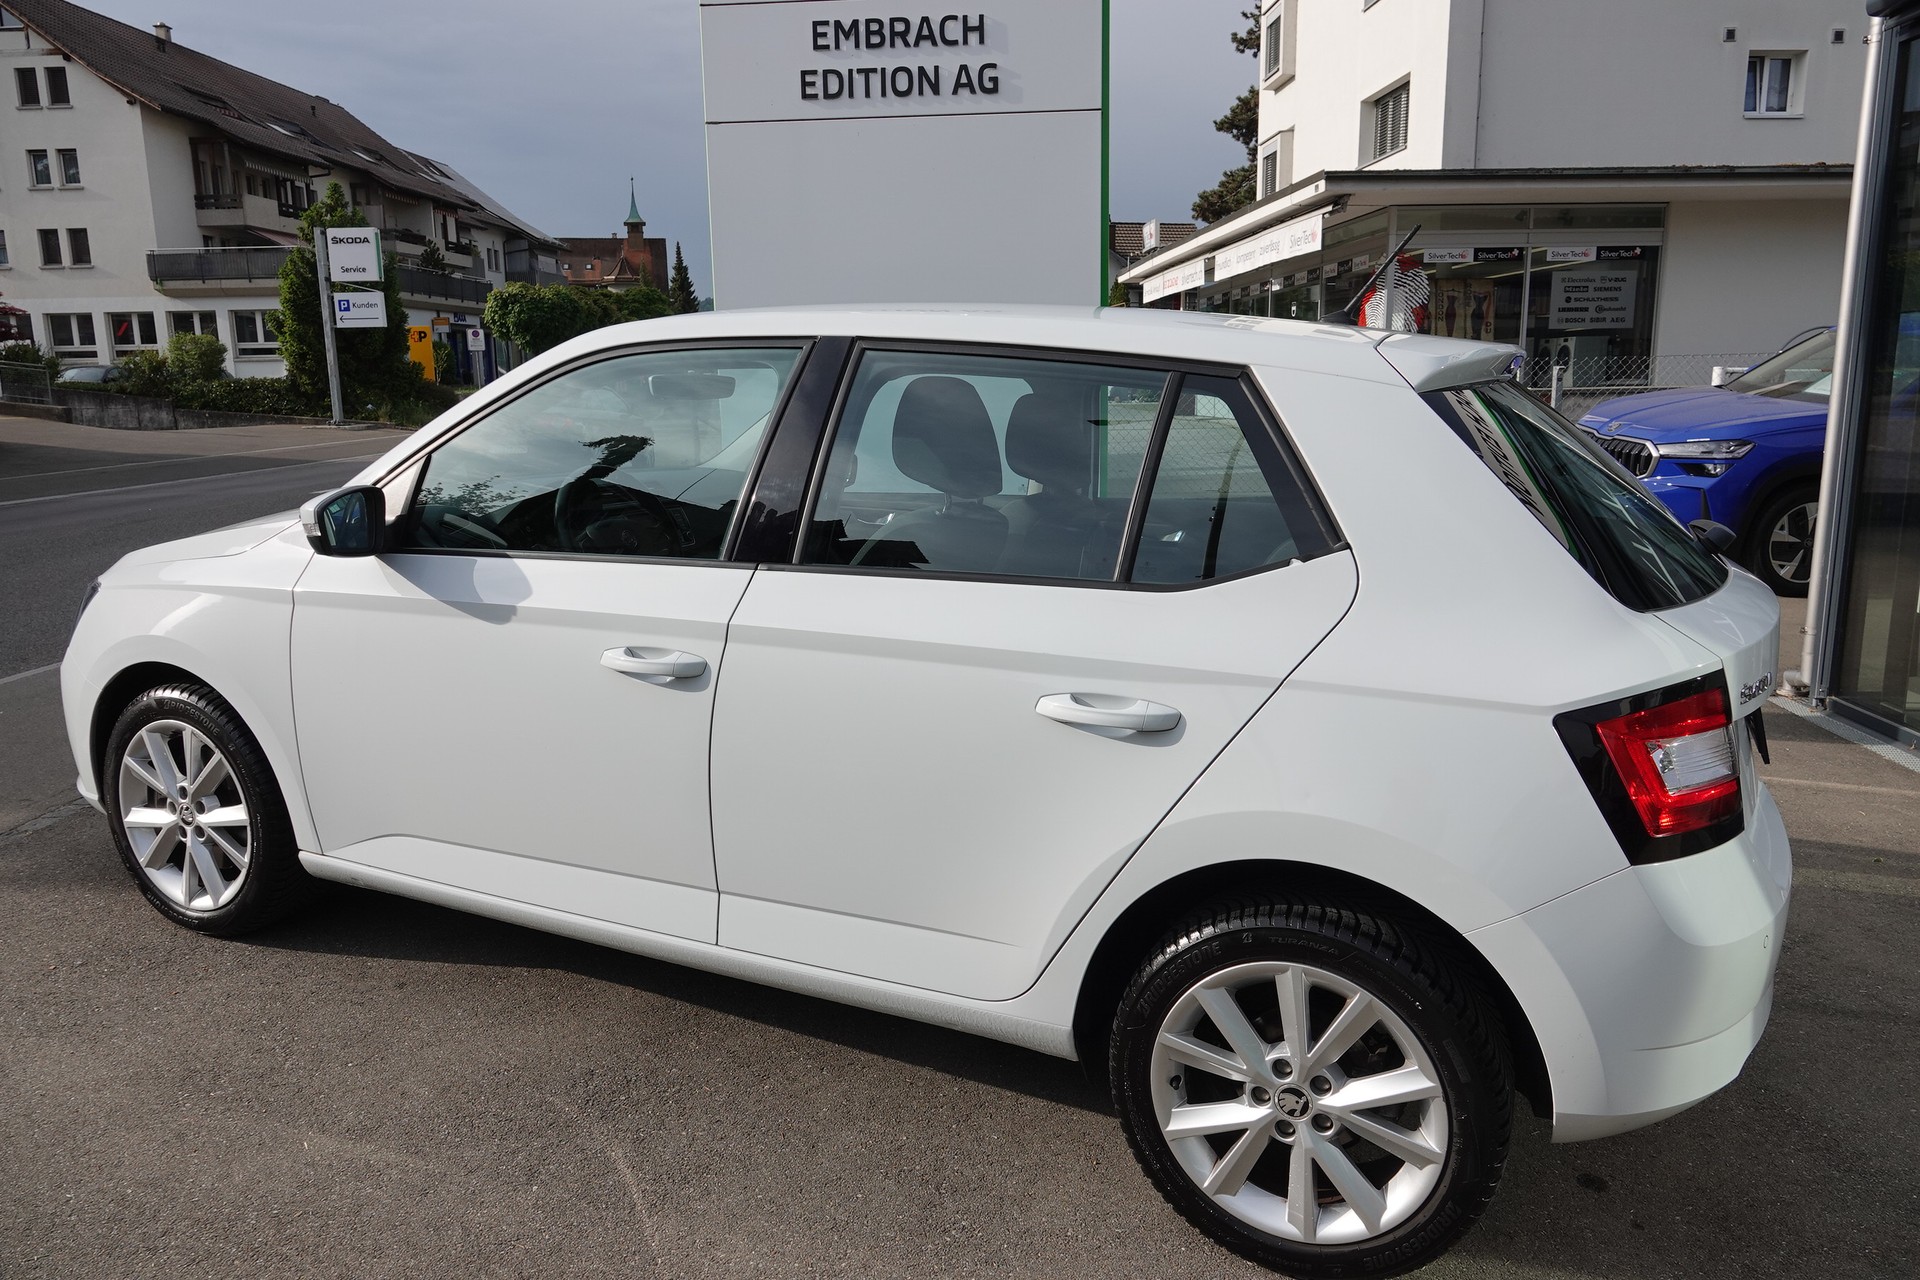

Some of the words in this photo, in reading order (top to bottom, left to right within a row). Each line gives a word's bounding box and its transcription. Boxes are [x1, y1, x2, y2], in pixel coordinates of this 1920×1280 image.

[812, 14, 985, 51] EMBRACH
[800, 65, 940, 100] EDITION
[952, 63, 999, 96] AG
[331, 236, 371, 245] ŠKODA
[341, 265, 367, 273] Service
[352, 301, 379, 309] Kunden
